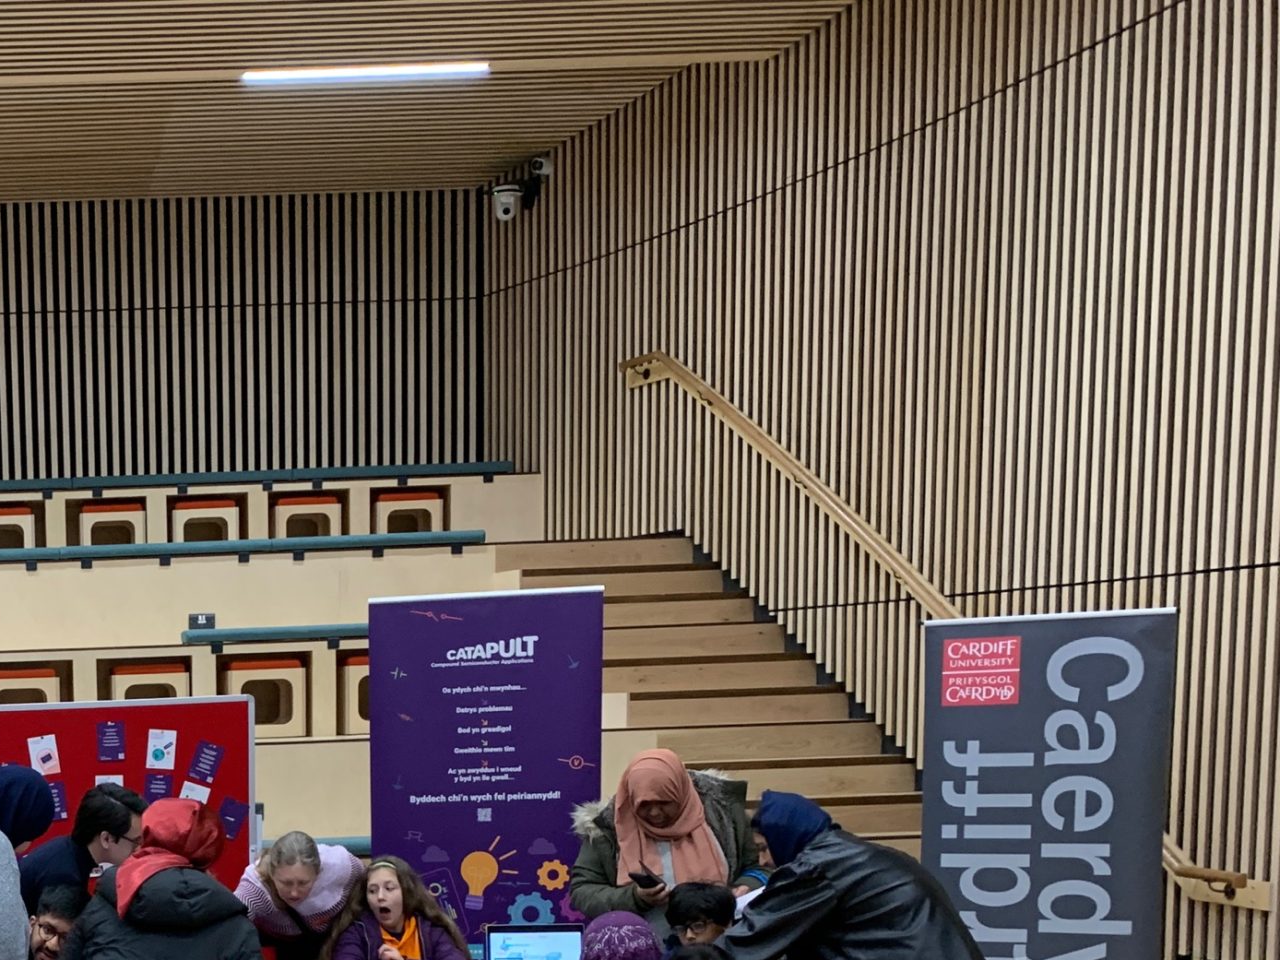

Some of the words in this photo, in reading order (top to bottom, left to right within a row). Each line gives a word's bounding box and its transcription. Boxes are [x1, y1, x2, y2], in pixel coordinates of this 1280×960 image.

[446, 635, 539, 660] CATAPULT
[948, 639, 1017, 658] CARDIFF
[950, 658, 1014, 667] UNIVERSITY
[948, 675, 1013, 686] PRIFYSGOL
[410, 795, 446, 805] Byddech
[447, 793, 469, 803] chi'n
[470, 792, 493, 803] wych
[493, 791, 506, 801] fel
[507, 791, 561, 802] peiriannydd!
